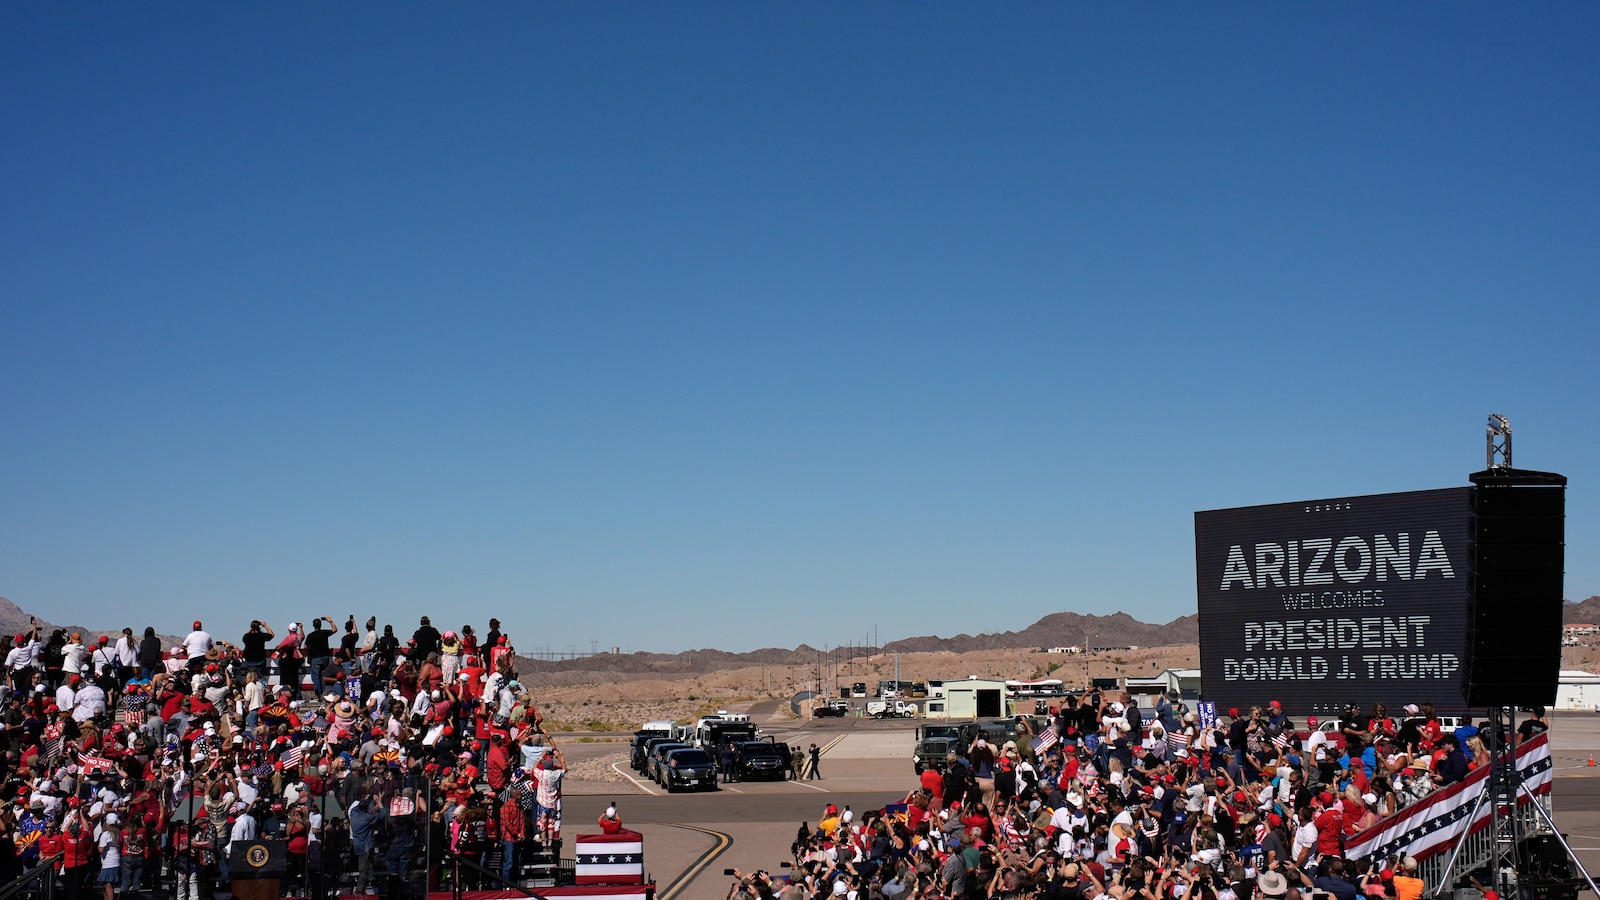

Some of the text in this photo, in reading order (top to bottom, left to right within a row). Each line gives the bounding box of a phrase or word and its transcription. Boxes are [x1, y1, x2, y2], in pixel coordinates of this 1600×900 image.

[1220, 530, 1455, 591] ARIZONA
[1282, 589, 1385, 611] WELCOMES
[1244, 615, 1431, 651] PRESIDENT
[1223, 653, 1459, 681] DONALD J. TRUMP
[1206, 703, 1213, 714] NO
